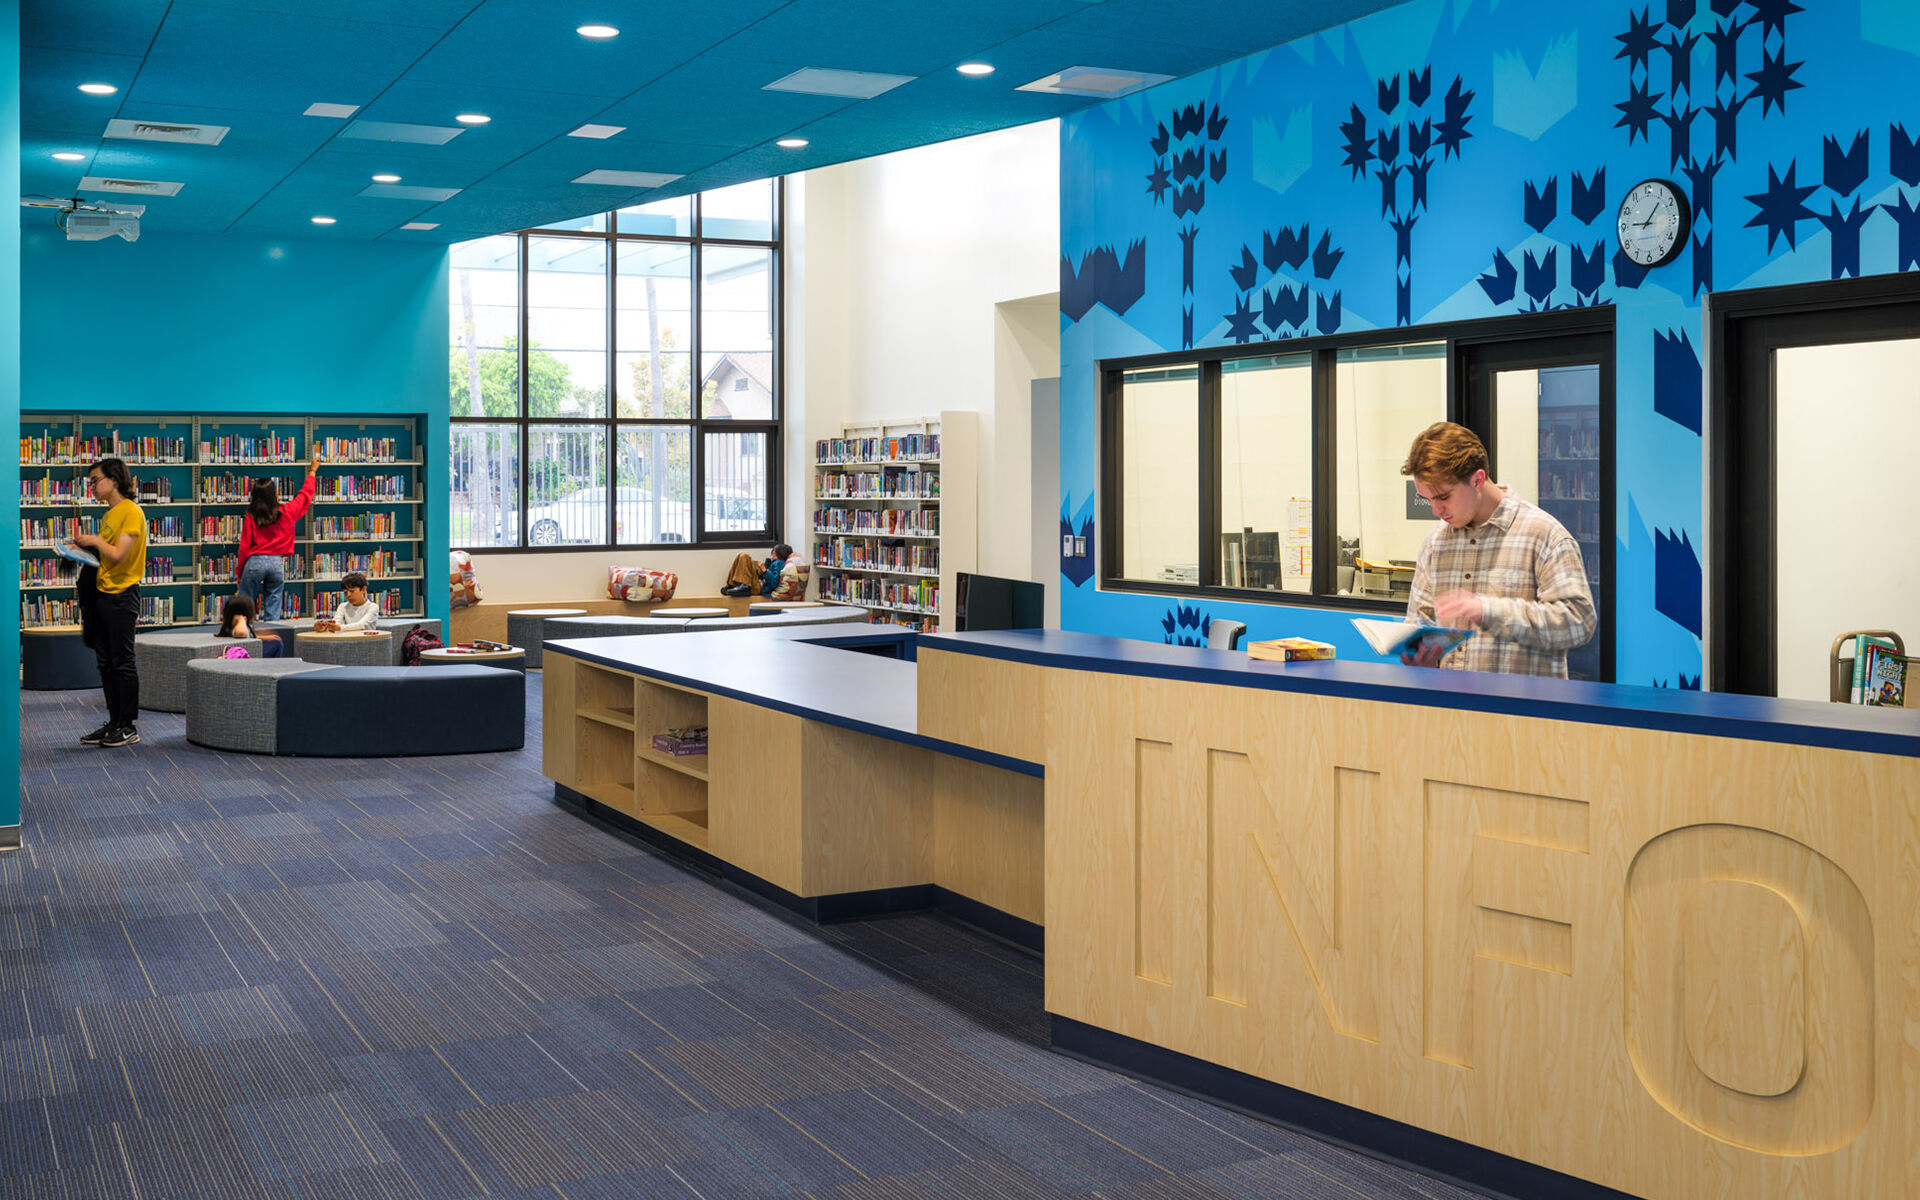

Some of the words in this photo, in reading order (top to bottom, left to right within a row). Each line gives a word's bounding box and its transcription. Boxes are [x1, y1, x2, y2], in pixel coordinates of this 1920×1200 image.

[1644, 185, 1652, 194] 12
[1625, 240, 1630, 249] 8
[1134, 737, 1876, 1158] INFO
